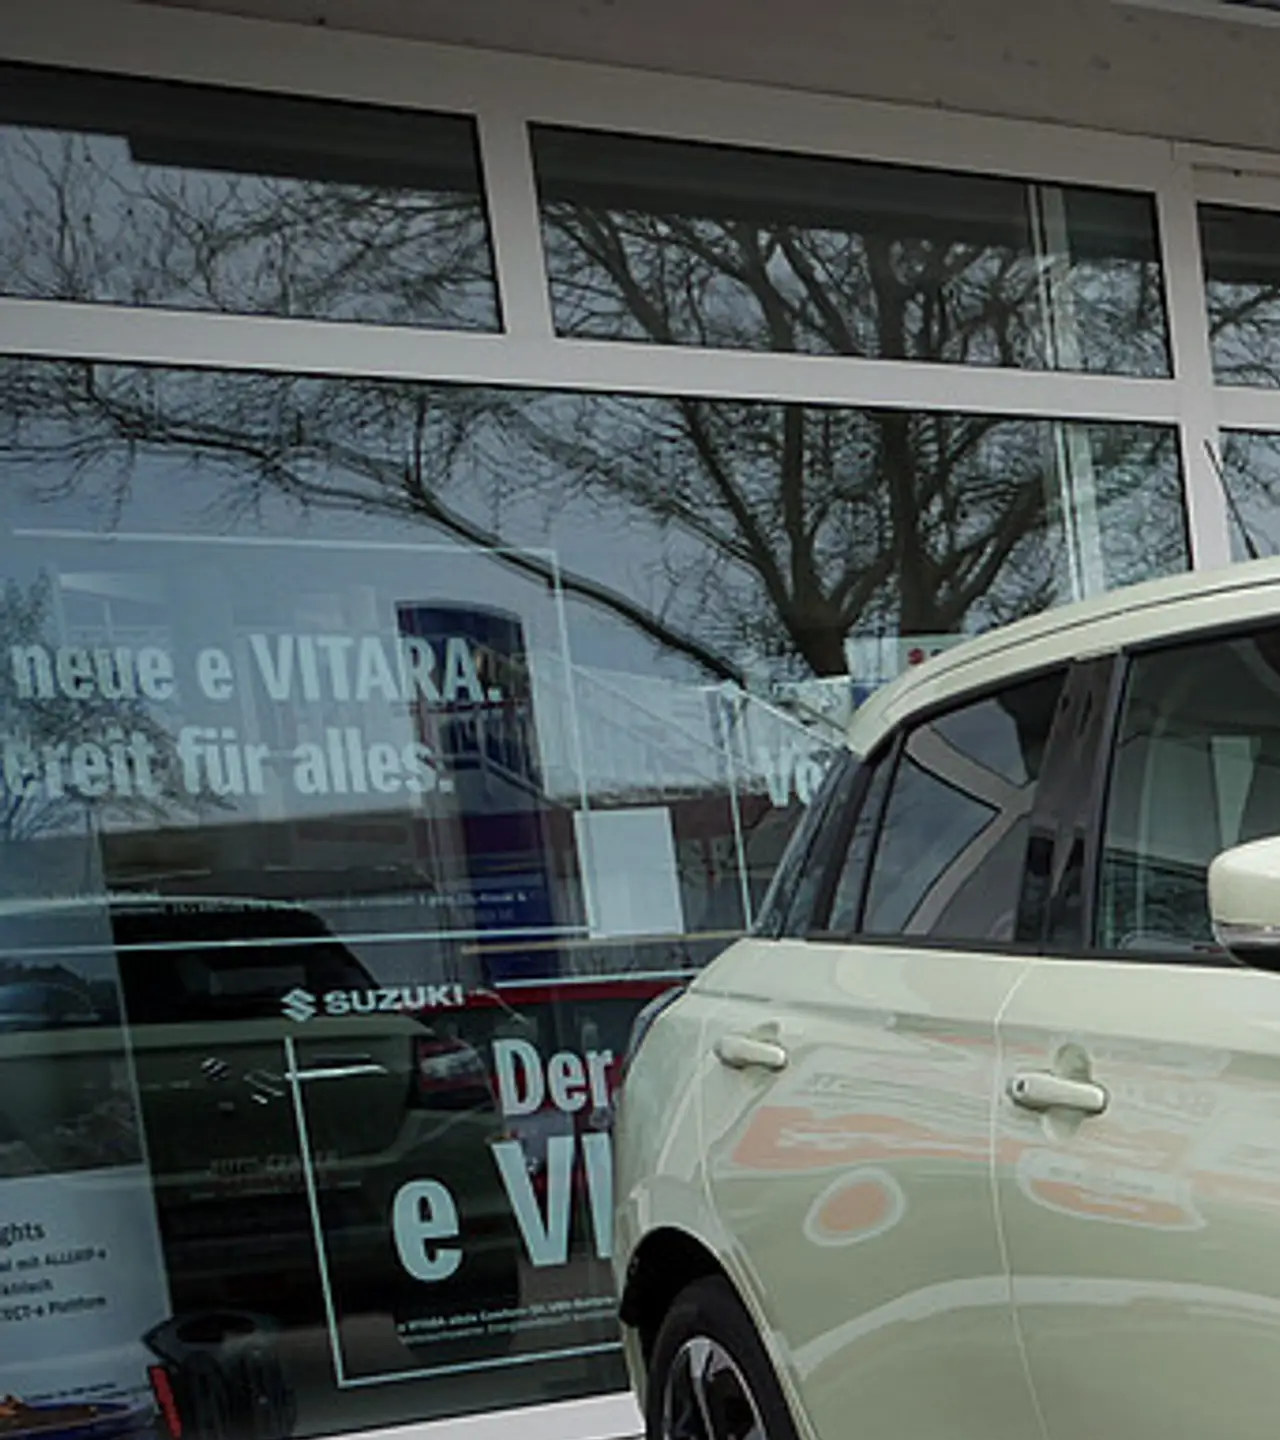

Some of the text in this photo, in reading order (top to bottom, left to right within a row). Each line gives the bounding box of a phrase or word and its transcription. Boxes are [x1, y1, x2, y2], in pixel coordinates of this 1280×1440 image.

[10, 633, 502, 704] neue e VITARA.
[178, 726, 270, 796] für
[292, 727, 454, 797] alles.
[322, 984, 467, 1016] SUZUKI
[493, 1037, 613, 1117] Der
[393, 1178, 463, 1282] e
